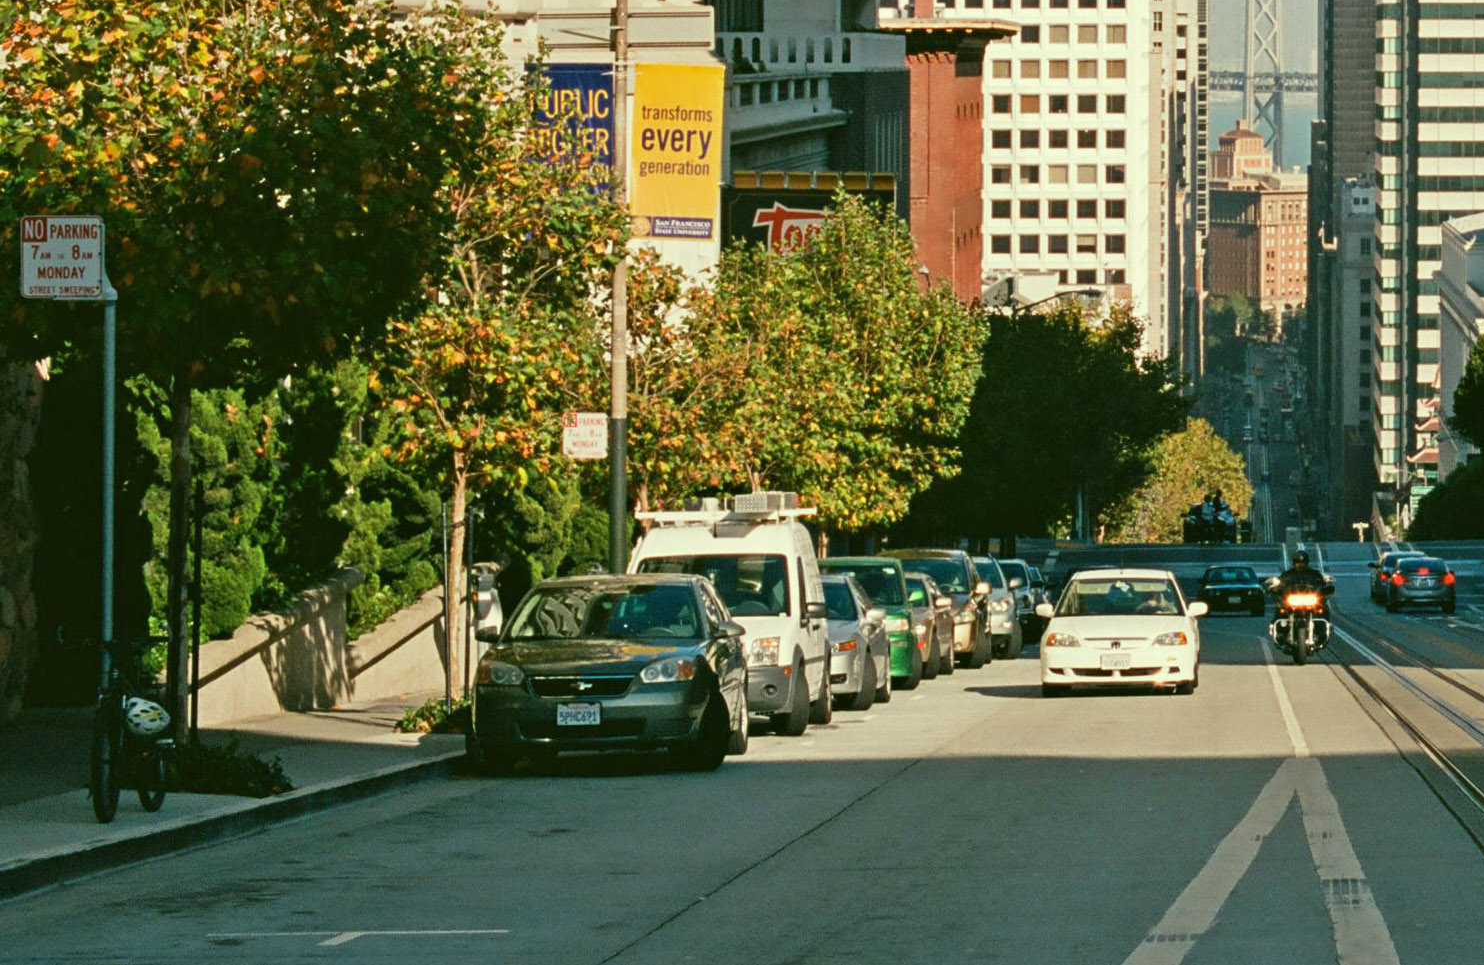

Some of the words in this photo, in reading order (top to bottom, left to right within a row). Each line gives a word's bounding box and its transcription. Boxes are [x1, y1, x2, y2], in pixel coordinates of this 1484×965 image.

[642, 105, 713, 122] transforms
[530, 128, 609, 156] IGHER
[641, 128, 713, 160] every
[639, 160, 710, 177] generation
[24, 219, 45, 240] NO
[50, 224, 98, 239] PARKING
[37, 266, 86, 279] MONDAY
